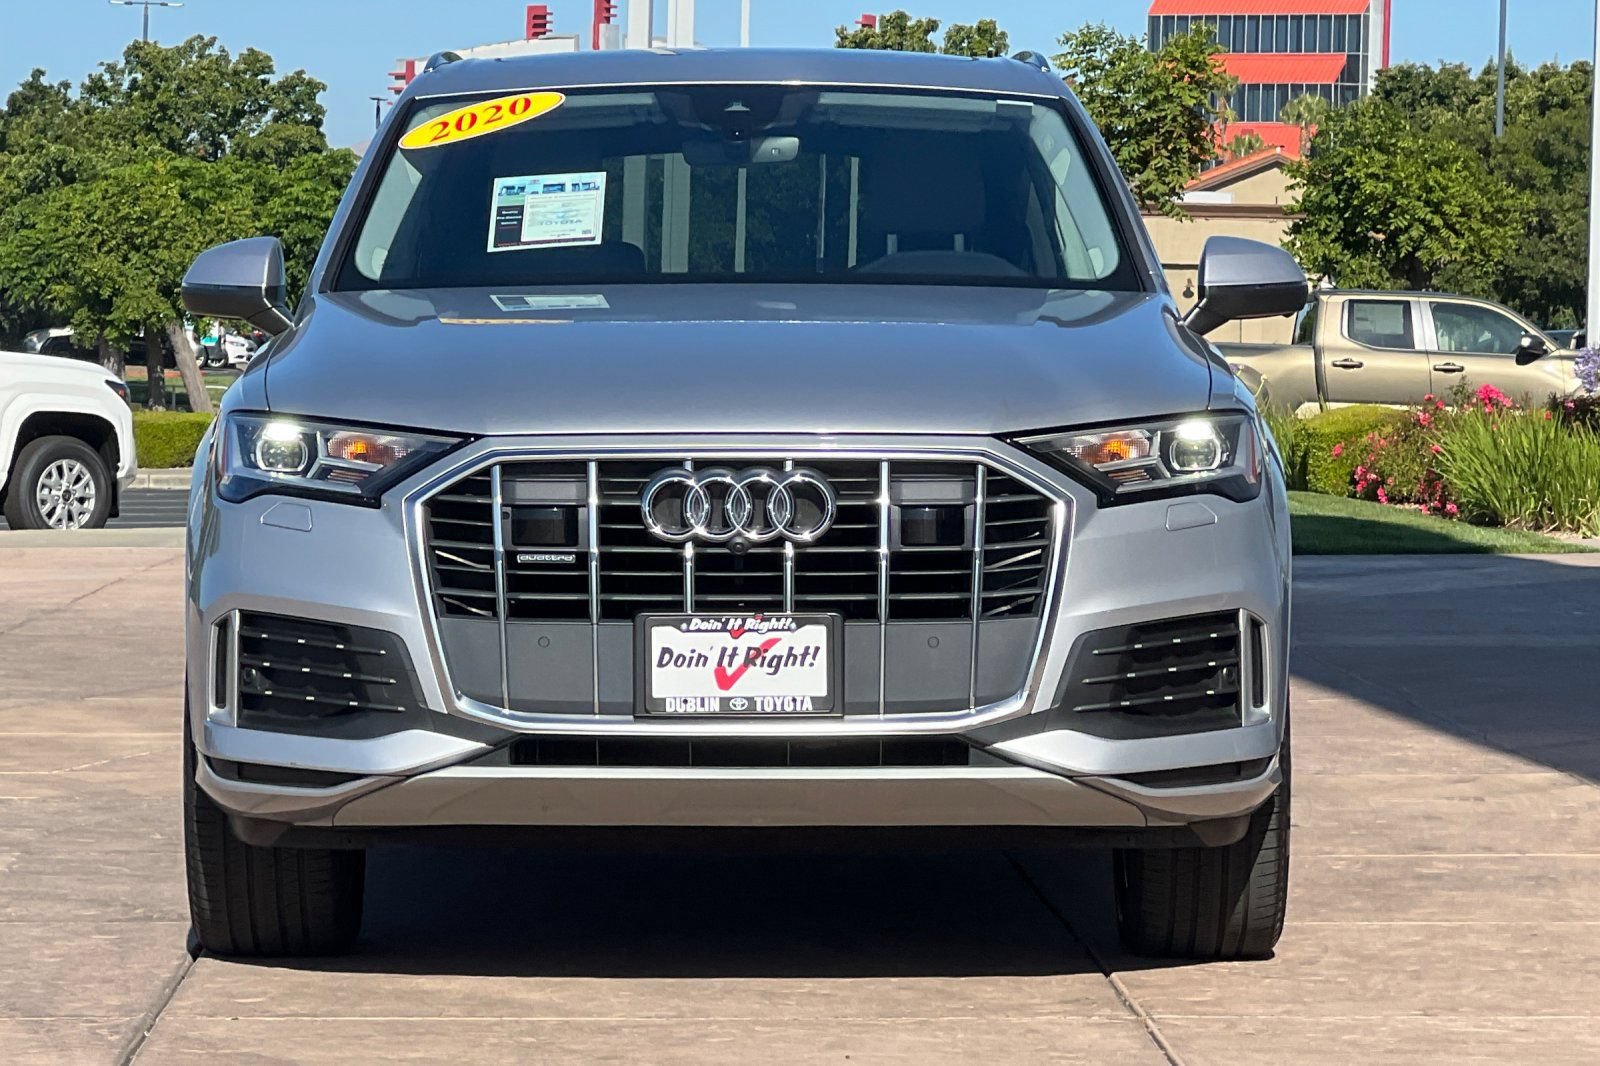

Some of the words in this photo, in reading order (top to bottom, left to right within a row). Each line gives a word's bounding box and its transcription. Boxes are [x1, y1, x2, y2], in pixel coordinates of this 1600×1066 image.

[429, 97, 532, 143] 2020
[689, 617, 725, 631] Doin'
[727, 617, 741, 631] It
[744, 616, 793, 633] Right!
[656, 645, 714, 669] Doin'
[716, 646, 741, 668] It
[743, 645, 821, 676] Right!
[665, 697, 720, 712] DUBLIN
[754, 696, 813, 712] TOYOTA
